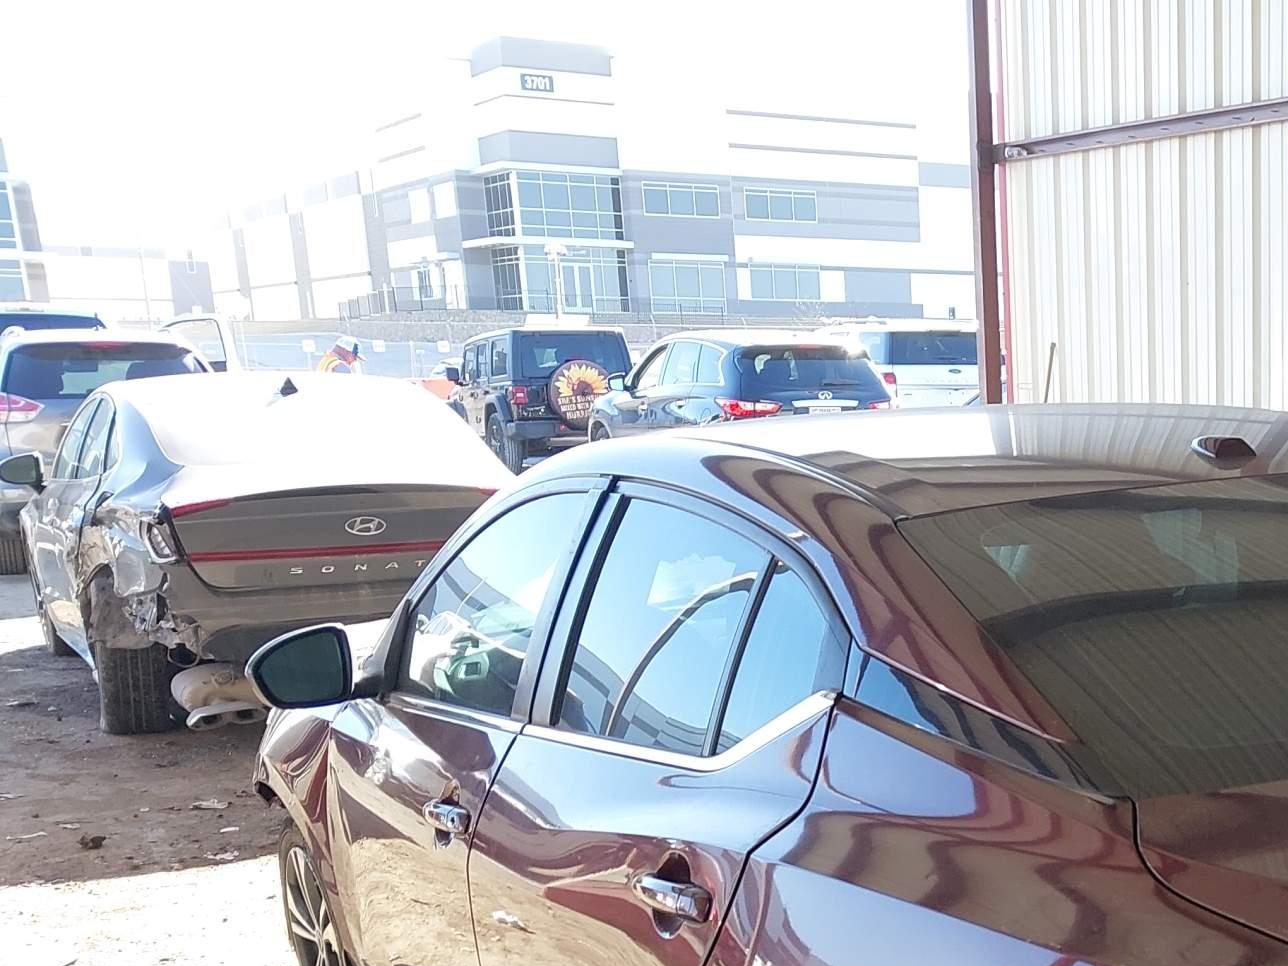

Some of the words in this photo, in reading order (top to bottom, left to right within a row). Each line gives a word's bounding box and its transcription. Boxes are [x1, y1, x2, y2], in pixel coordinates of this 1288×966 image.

[524, 75, 550, 90] 3701
[577, 402, 589, 410] WITH
[289, 560, 426, 574] SONAT
